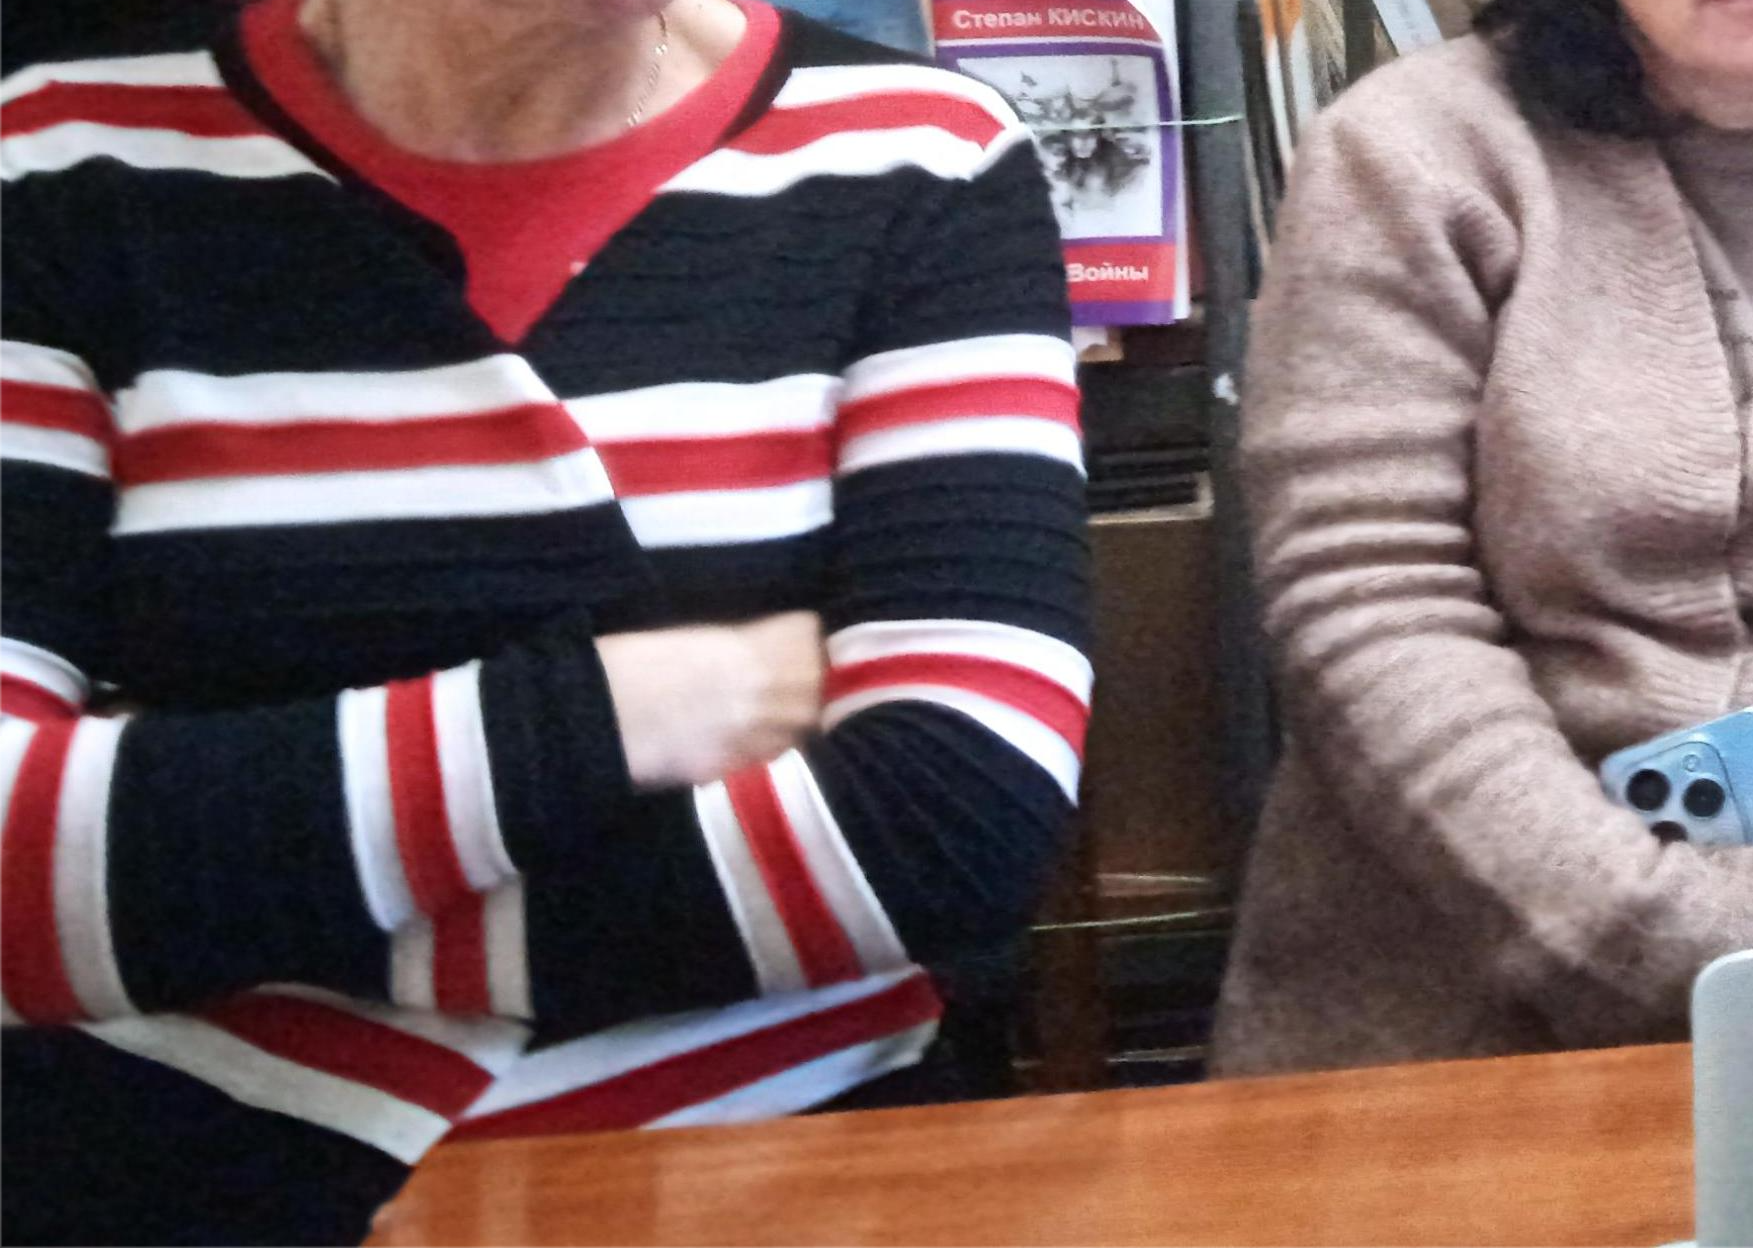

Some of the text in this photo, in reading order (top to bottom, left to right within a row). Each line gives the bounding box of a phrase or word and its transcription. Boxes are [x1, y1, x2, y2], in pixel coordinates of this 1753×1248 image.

[953, 7, 1145, 30] Степан КИСКИН
[1066, 261, 1149, 283] Войны
